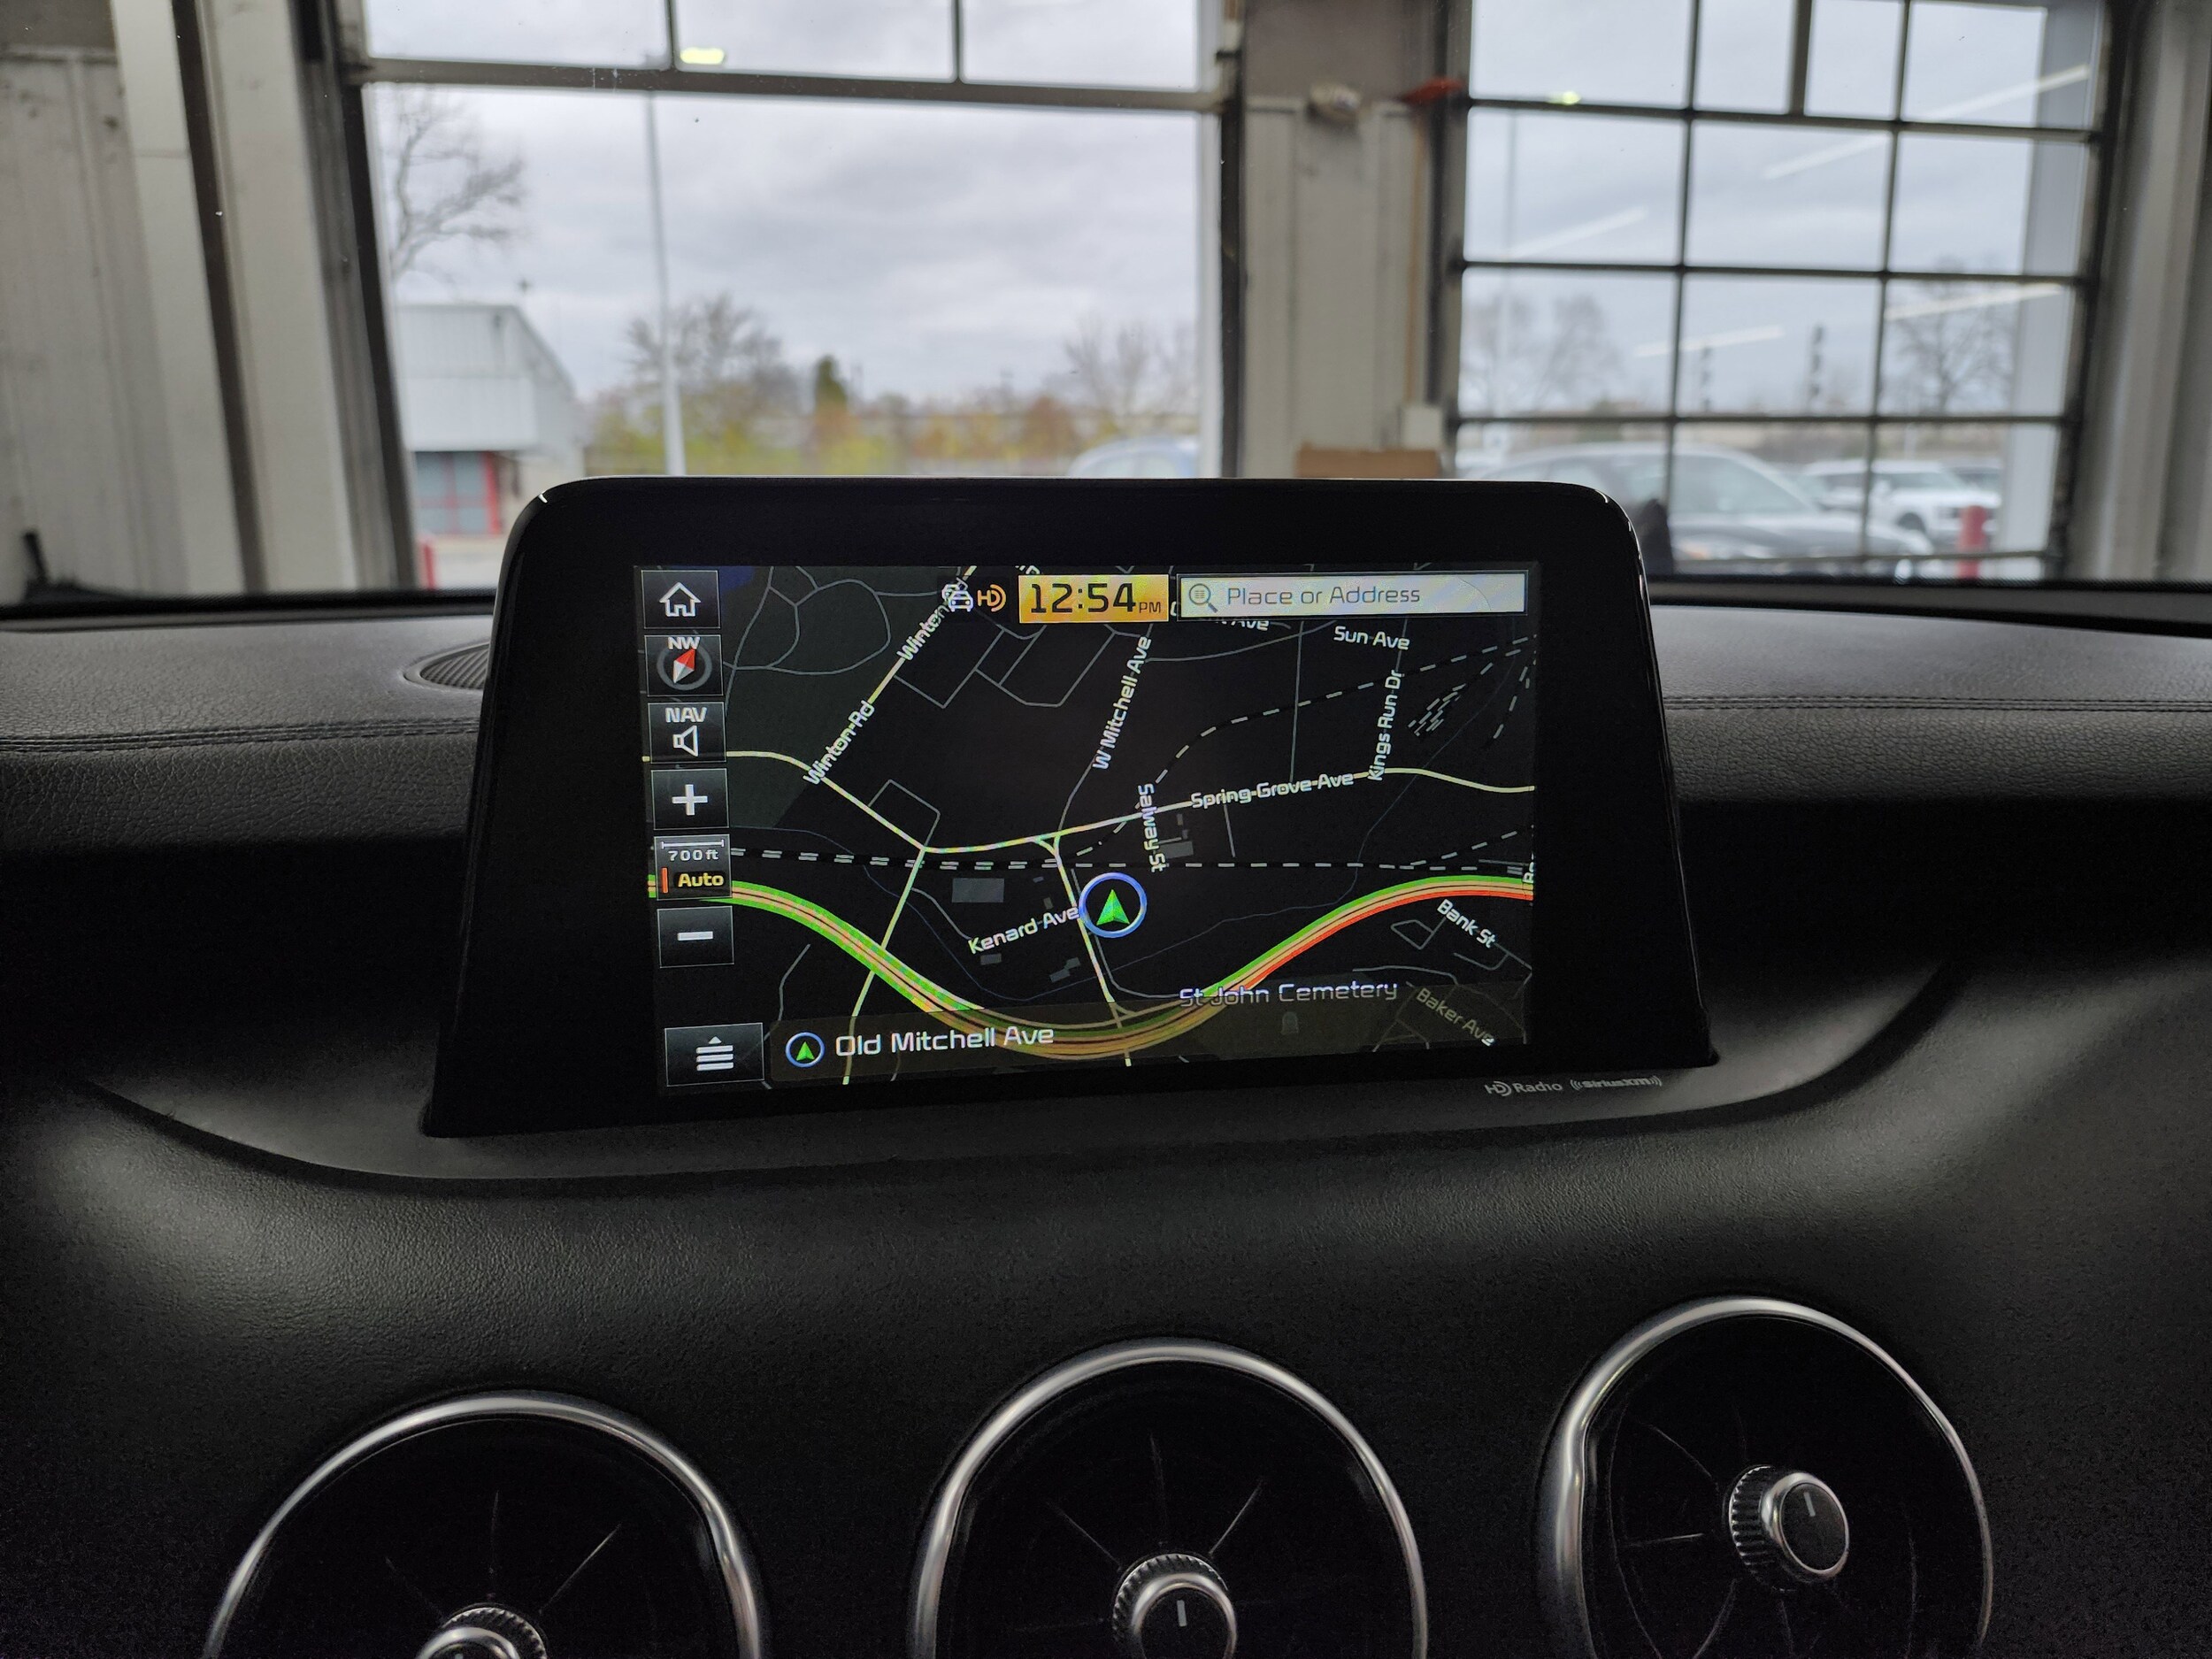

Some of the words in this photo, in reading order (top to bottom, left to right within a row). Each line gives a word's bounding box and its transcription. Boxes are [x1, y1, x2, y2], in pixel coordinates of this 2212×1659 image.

[1030, 583, 1136, 613] 12:54
[1139, 602, 1162, 614] PM
[1227, 588, 1293, 605] Place
[1300, 588, 1323, 604] or
[1329, 585, 1420, 604] Address
[667, 636, 701, 650] NW
[896, 603, 950, 661] Winton
[1333, 626, 1369, 645] Sun
[1373, 631, 1410, 650] Ave
[1126, 635, 1152, 674] Ave
[1384, 670, 1403, 690] Dr
[664, 707, 708, 723] NAV
[1100, 674, 1138, 749] Mitchell
[1377, 695, 1399, 729] Run
[803, 726, 856, 785] Winton
[849, 700, 875, 727] Rd
[1368, 733, 1392, 780] Kings
[1093, 752, 1112, 770] W
[1191, 788, 1252, 809] Spring
[1256, 778, 1312, 798] Grove
[1317, 772, 1355, 790] Ave
[1138, 783, 1159, 850] Salway
[1149, 853, 1166, 873] St
[667, 849, 703, 862] 700
[705, 849, 718, 861] ft
[678, 872, 725, 888] Auto
[967, 918, 1040, 955] Kenard
[1041, 906, 1081, 931] Ave
[1437, 898, 1479, 936] Bank
[1476, 929, 1496, 949] St
[1179, 987, 1205, 1007] St
[1210, 986, 1270, 1006] John
[1279, 980, 1398, 1002] Cemetery
[1417, 987, 1463, 1025] Baker
[1461, 1018, 1496, 1048] Ave
[835, 1035, 882, 1056] Old
[890, 1027, 996, 1054] Mitchell
[1003, 1025, 1056, 1049] Ave
[1513, 1081, 1564, 1094] Radio
